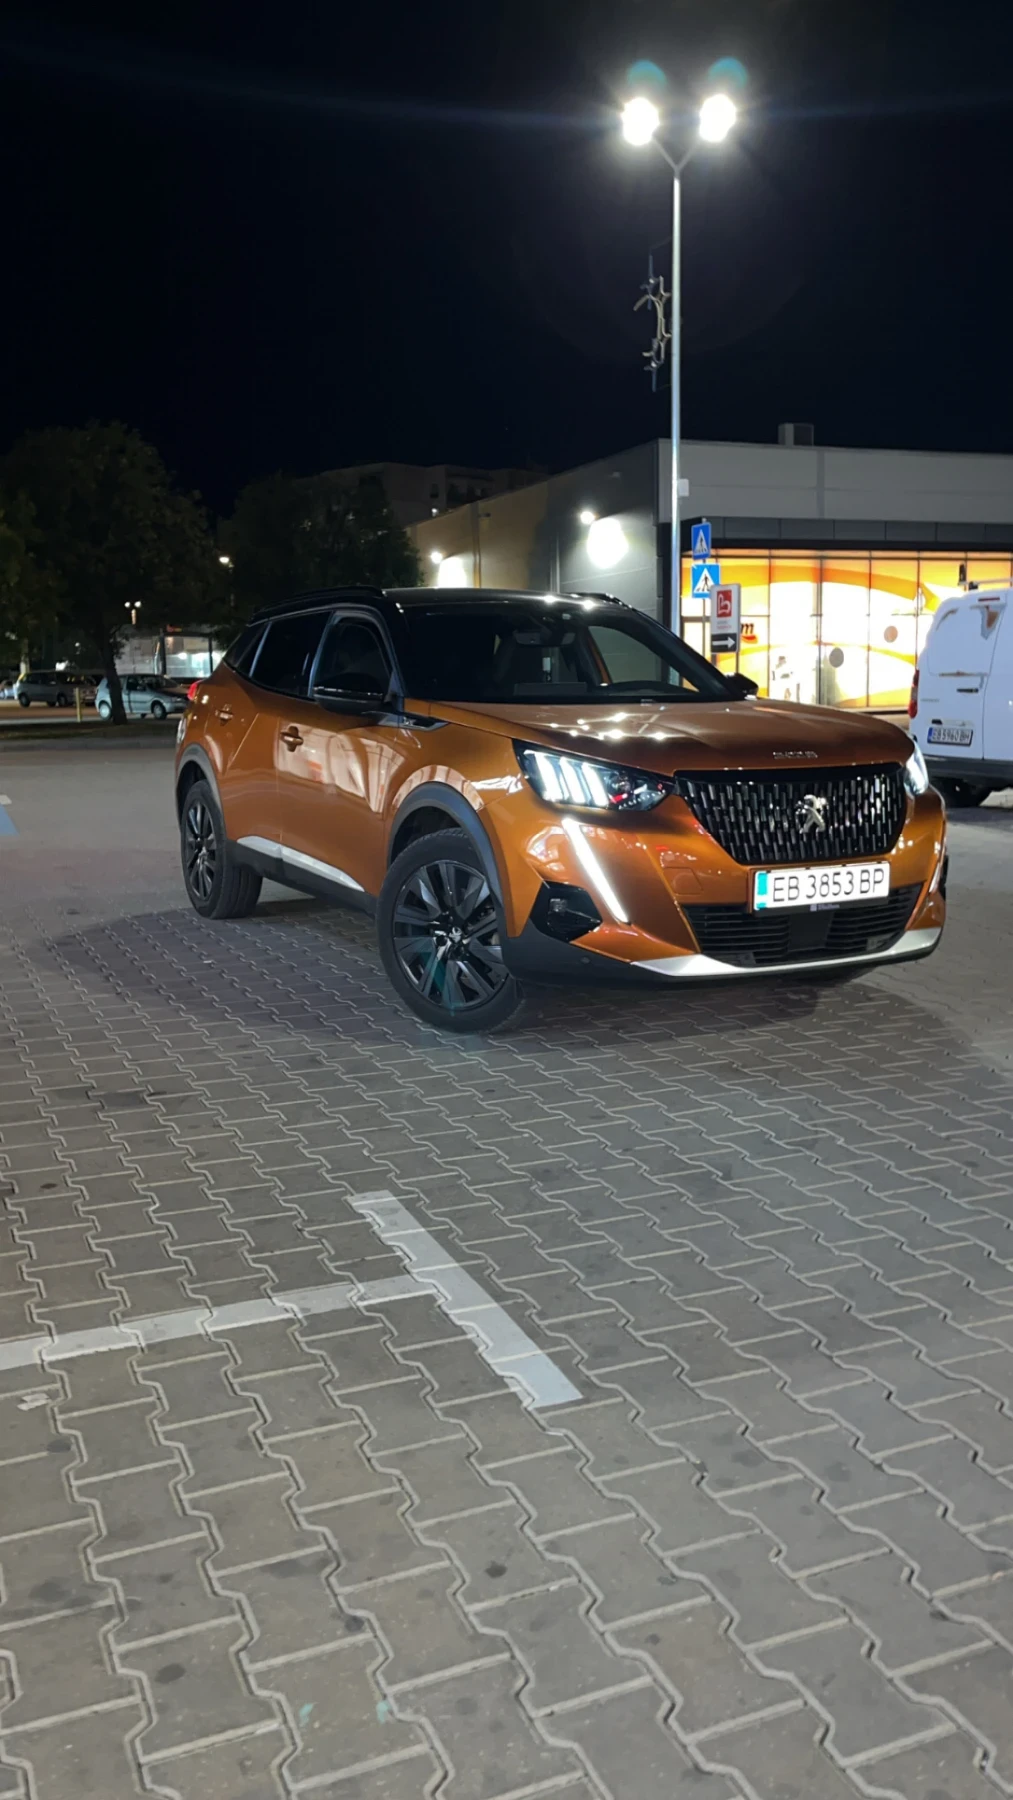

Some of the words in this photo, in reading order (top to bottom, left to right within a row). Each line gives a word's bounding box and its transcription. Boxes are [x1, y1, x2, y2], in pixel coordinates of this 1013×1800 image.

[773, 876, 800, 902] EB
[806, 871, 854, 899] 3853
[860, 868, 884, 894] BP
